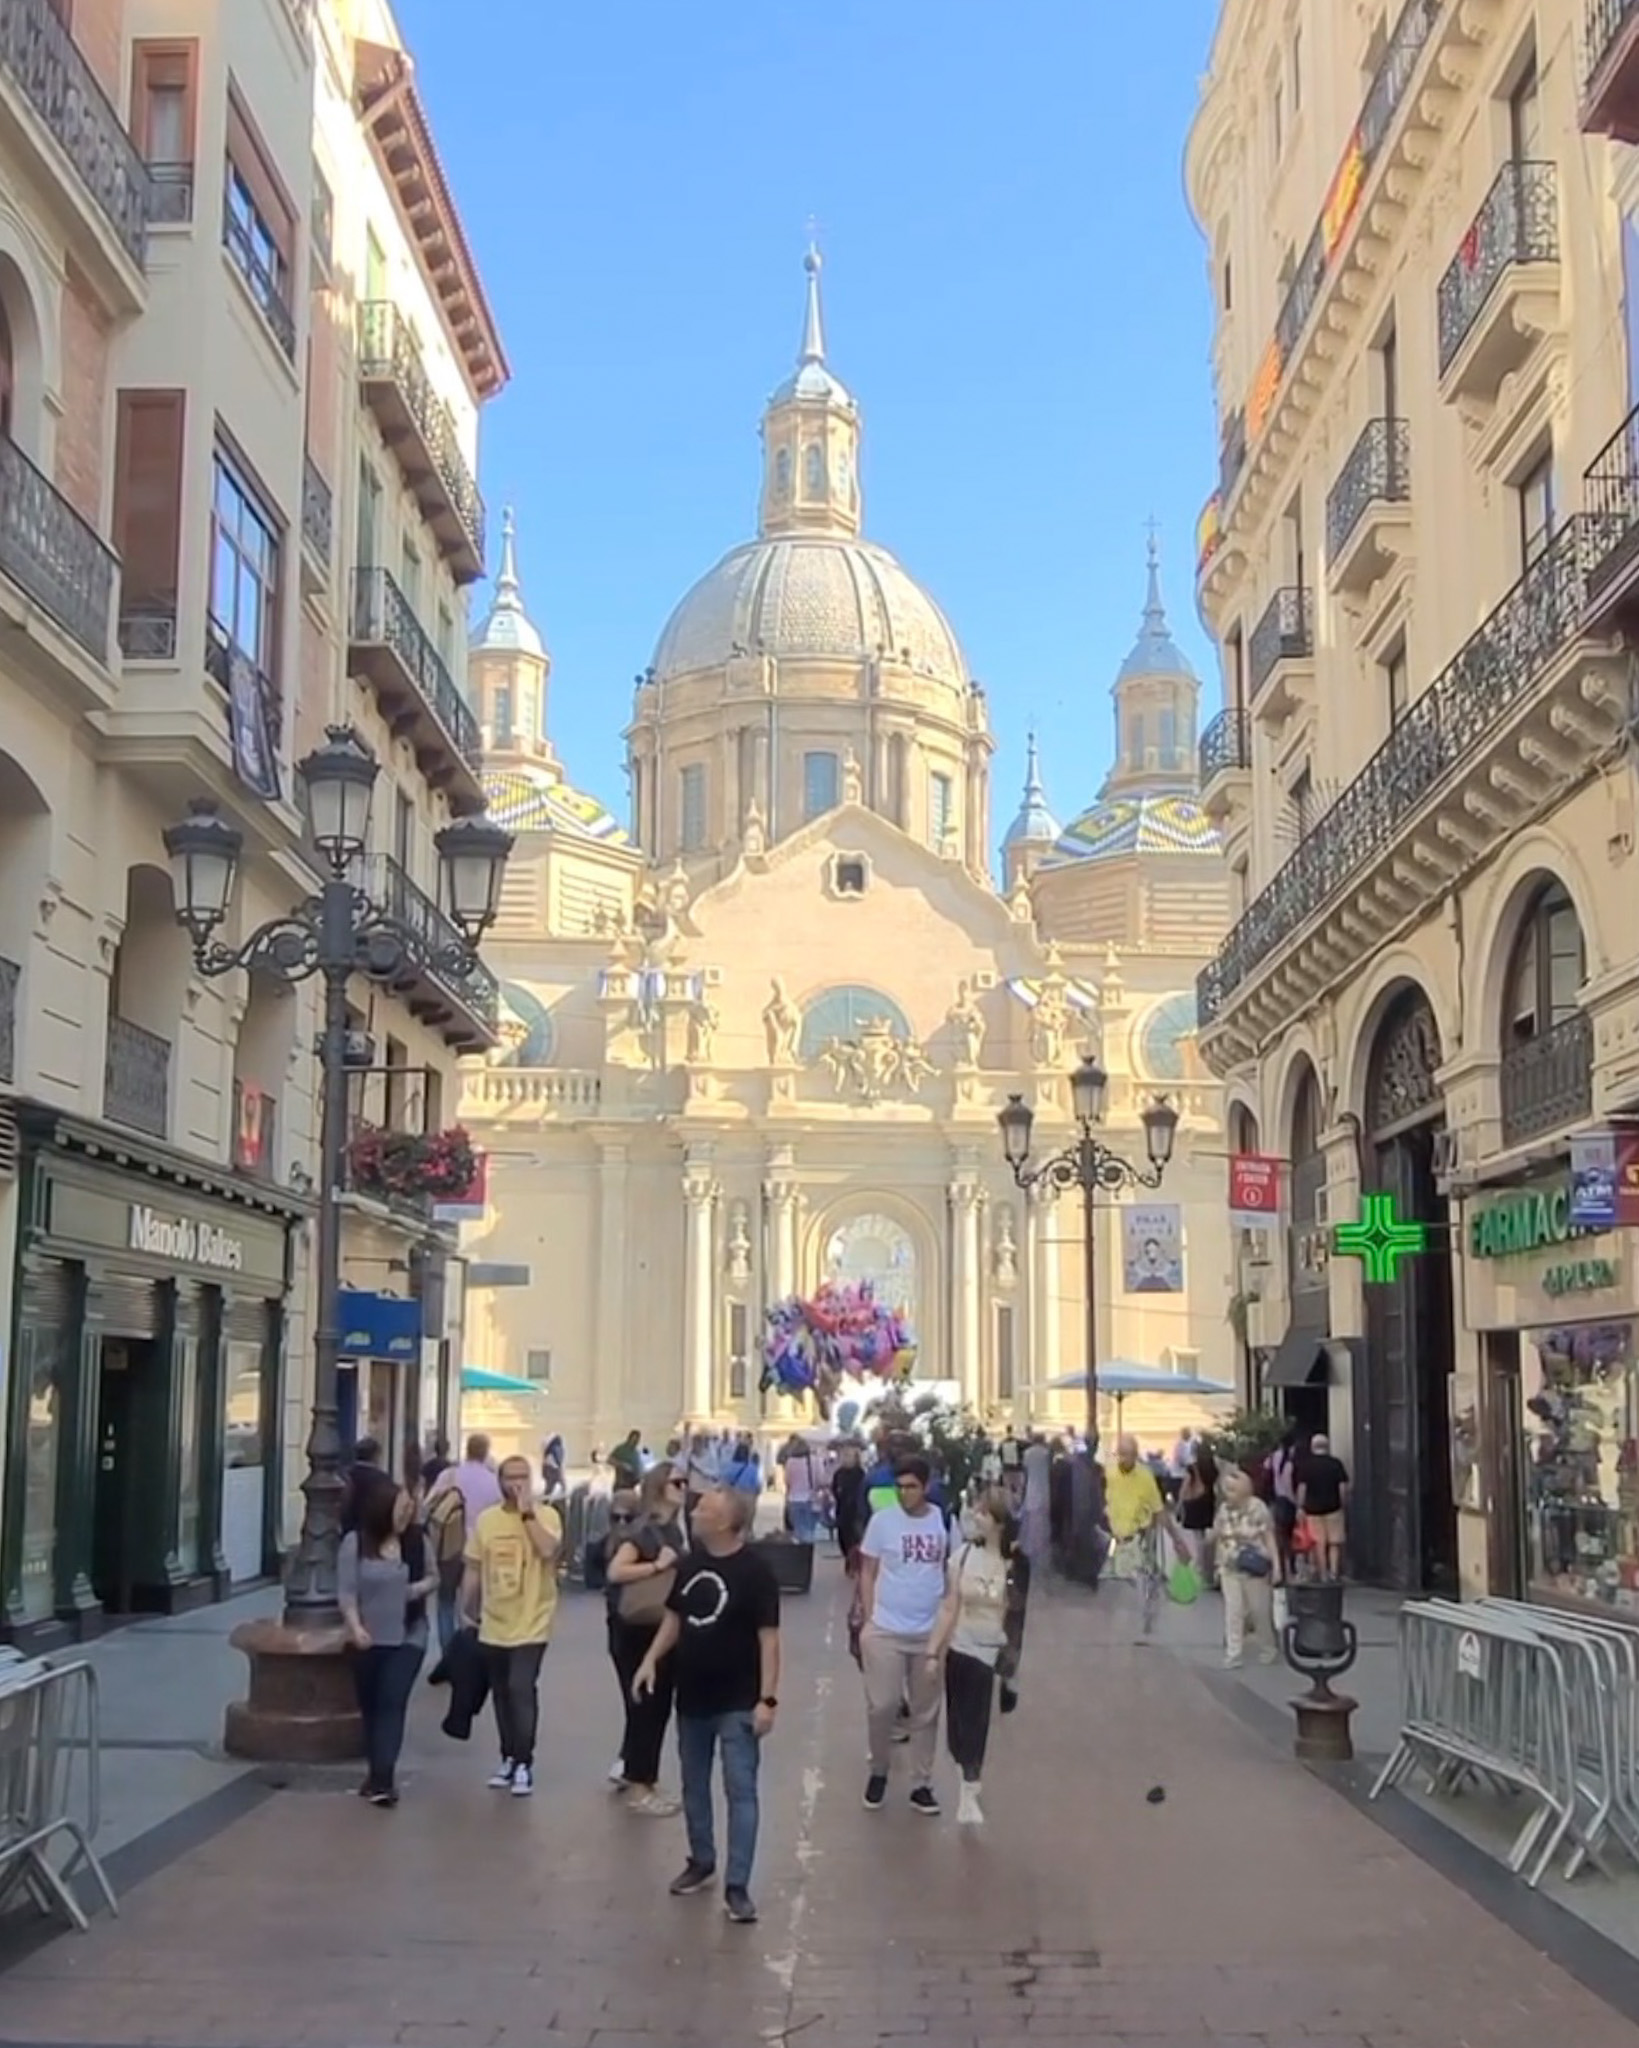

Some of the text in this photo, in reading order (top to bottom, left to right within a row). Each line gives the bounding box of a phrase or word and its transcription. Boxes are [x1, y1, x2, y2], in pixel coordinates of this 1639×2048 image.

[130, 1203, 242, 1271] Manolo Bakes
[1471, 1186, 1604, 1260] FARMAC
